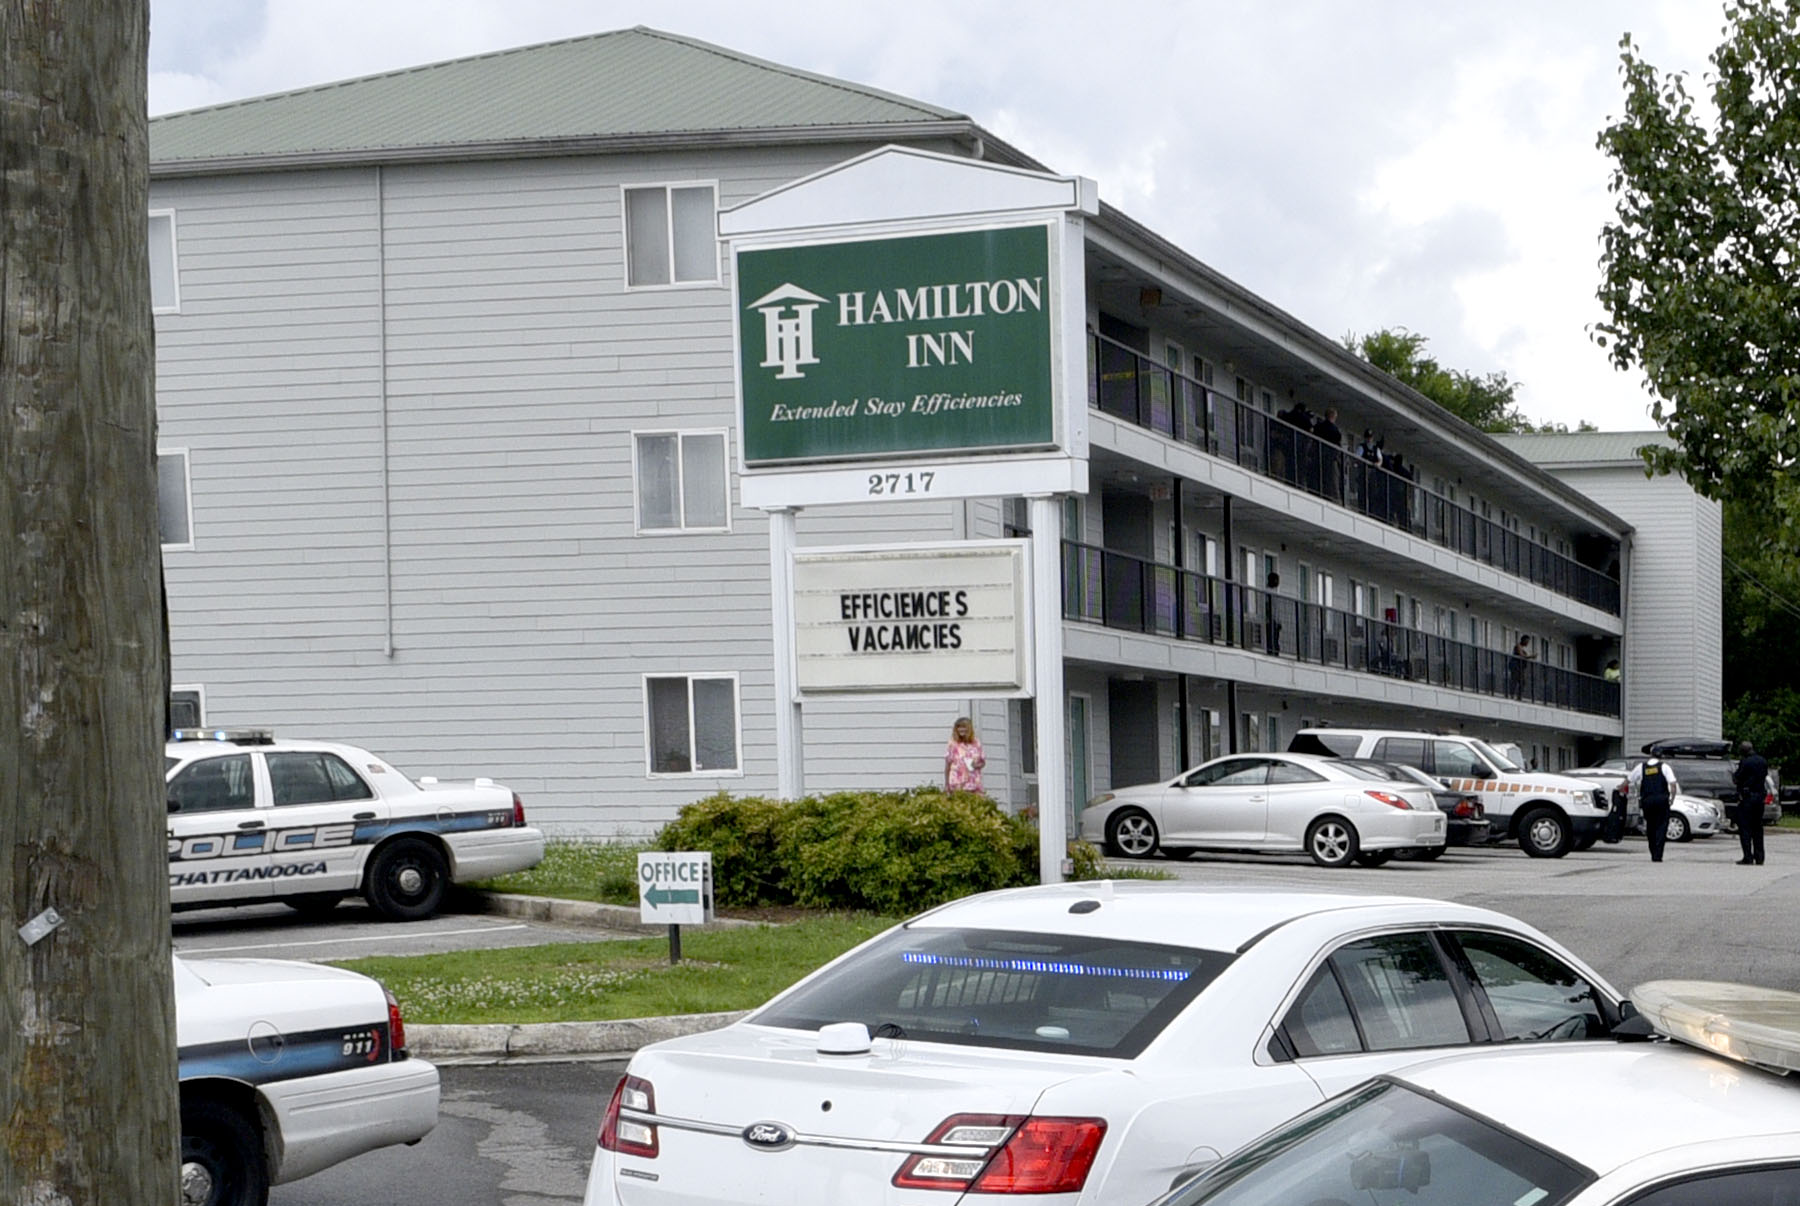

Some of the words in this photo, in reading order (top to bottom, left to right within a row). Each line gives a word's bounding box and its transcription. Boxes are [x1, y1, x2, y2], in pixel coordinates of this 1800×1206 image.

[836, 277, 1042, 326] HAMILTON
[906, 330, 974, 368] INN
[770, 400, 858, 422] Extended
[864, 397, 906, 417] Stay
[911, 390, 1022, 414] Efficiencies
[868, 472, 934, 495] 2717
[848, 623, 962, 652] VACANCIES
[641, 862, 699, 882] OFFICE
[343, 1040, 372, 1056] 911
[749, 1125, 781, 1142] Ford
